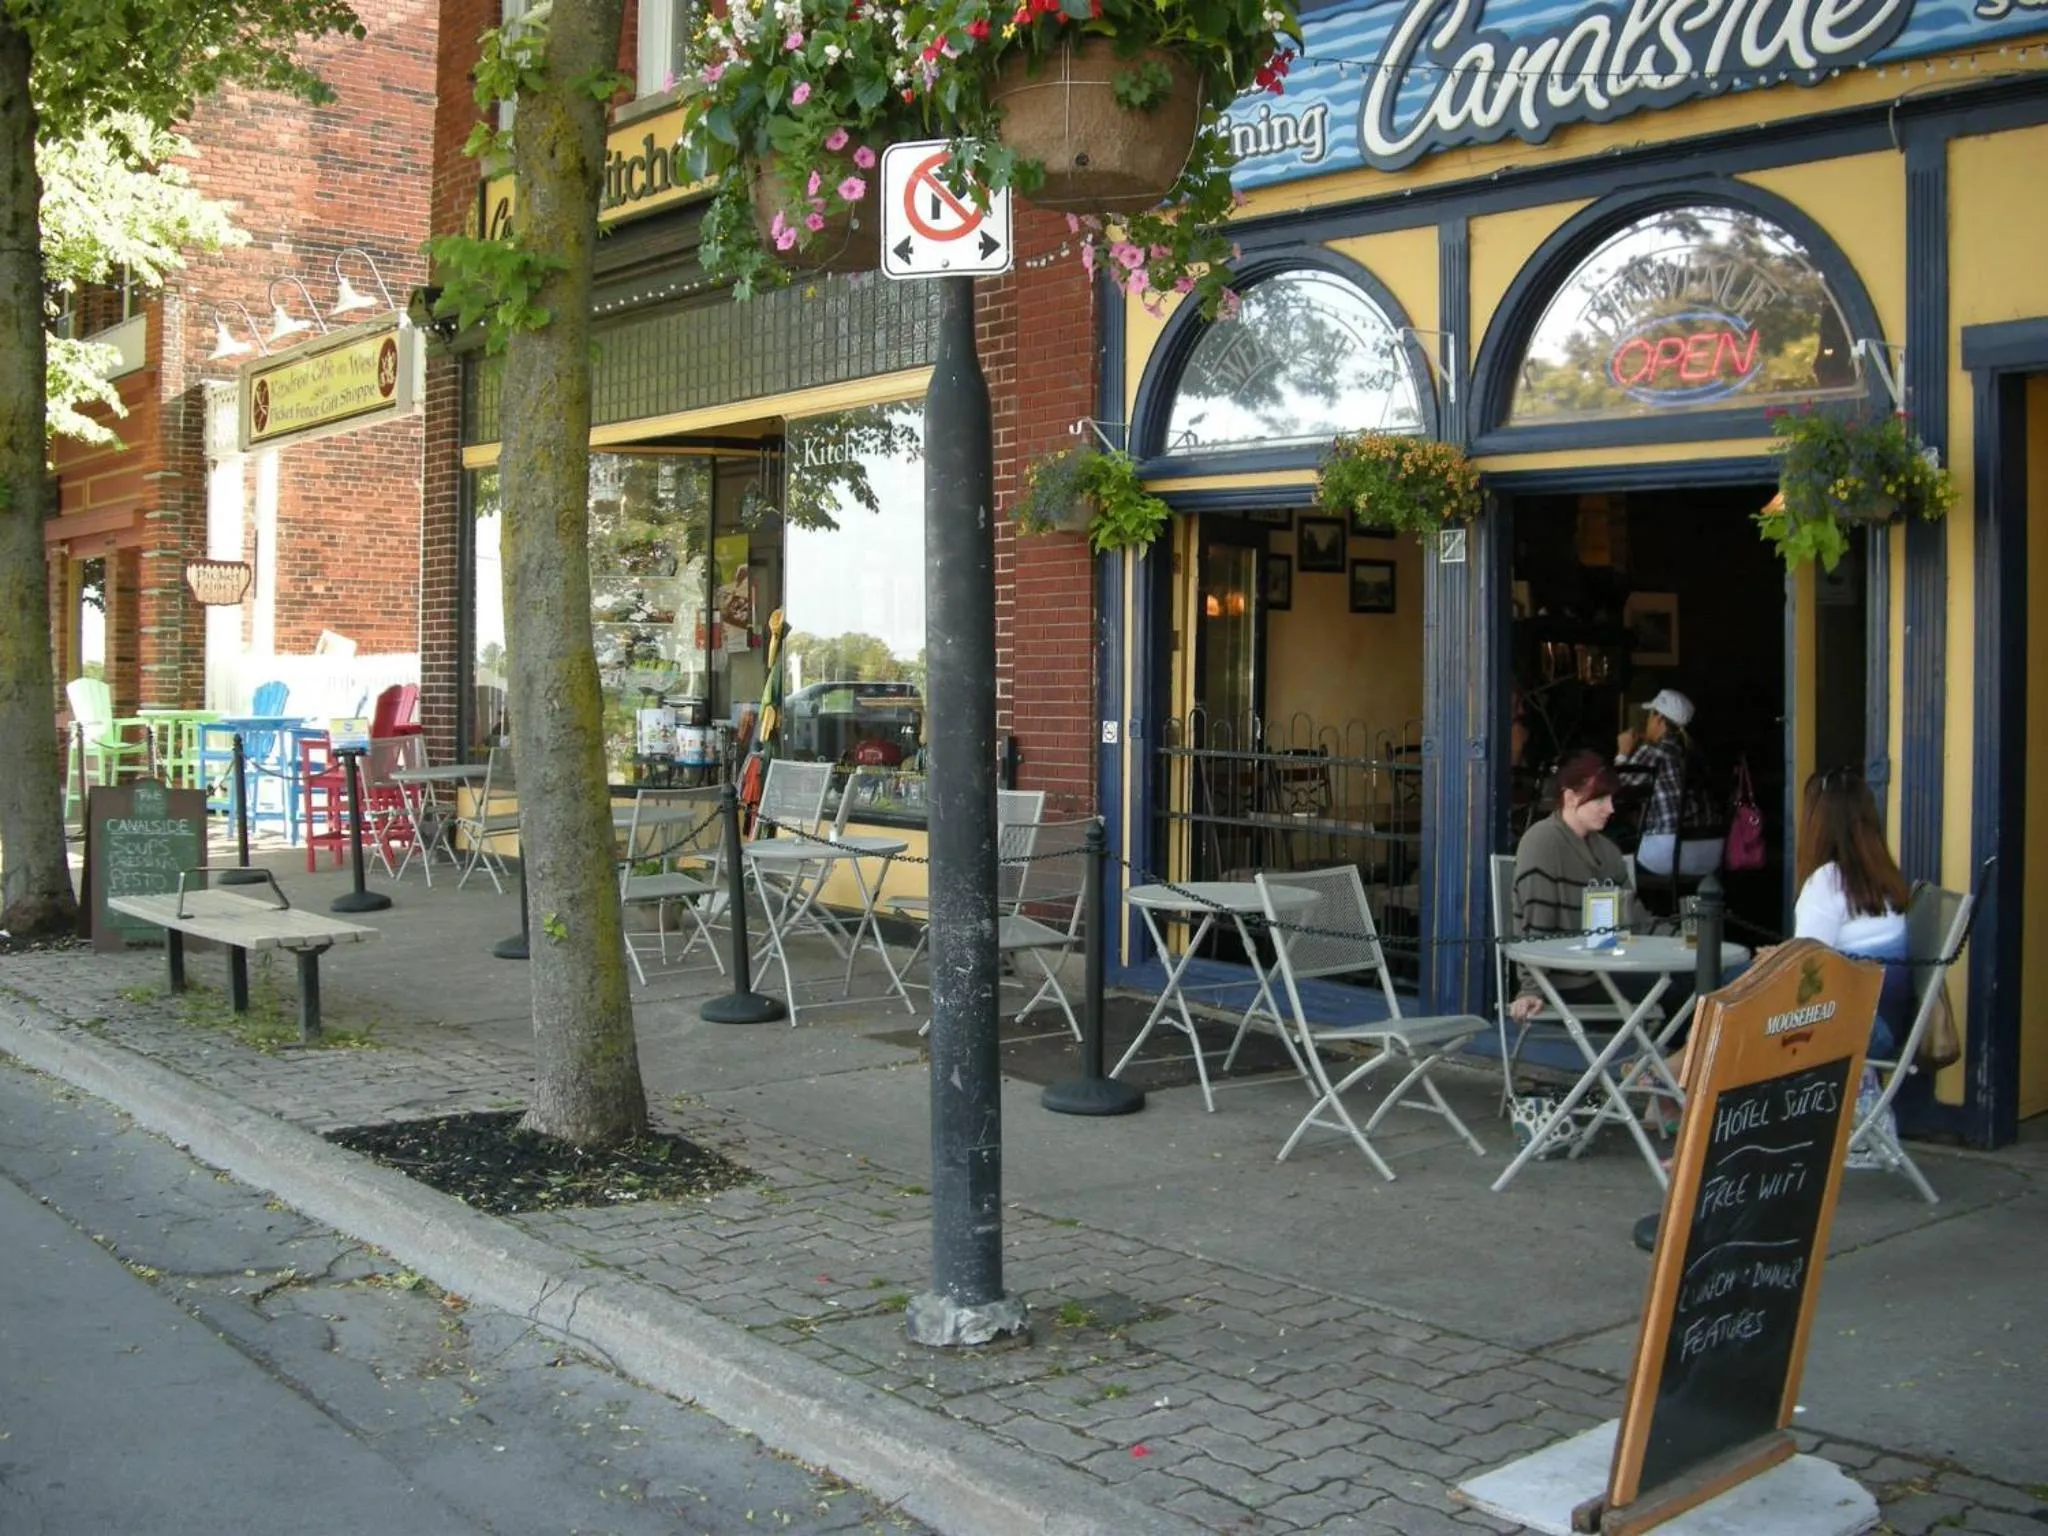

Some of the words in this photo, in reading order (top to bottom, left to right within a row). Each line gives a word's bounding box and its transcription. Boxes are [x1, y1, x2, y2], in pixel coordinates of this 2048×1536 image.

[1217, 103, 1329, 163] ining
[604, 133, 688, 208] itch
[1612, 327, 1761, 385] OPEN
[1764, 999, 1836, 1036] MOOSEHEAD
[1714, 1098, 1770, 1143] HOTEL
[1781, 1080, 1839, 1121] SUITES
[1700, 1173, 1751, 1219] FREE
